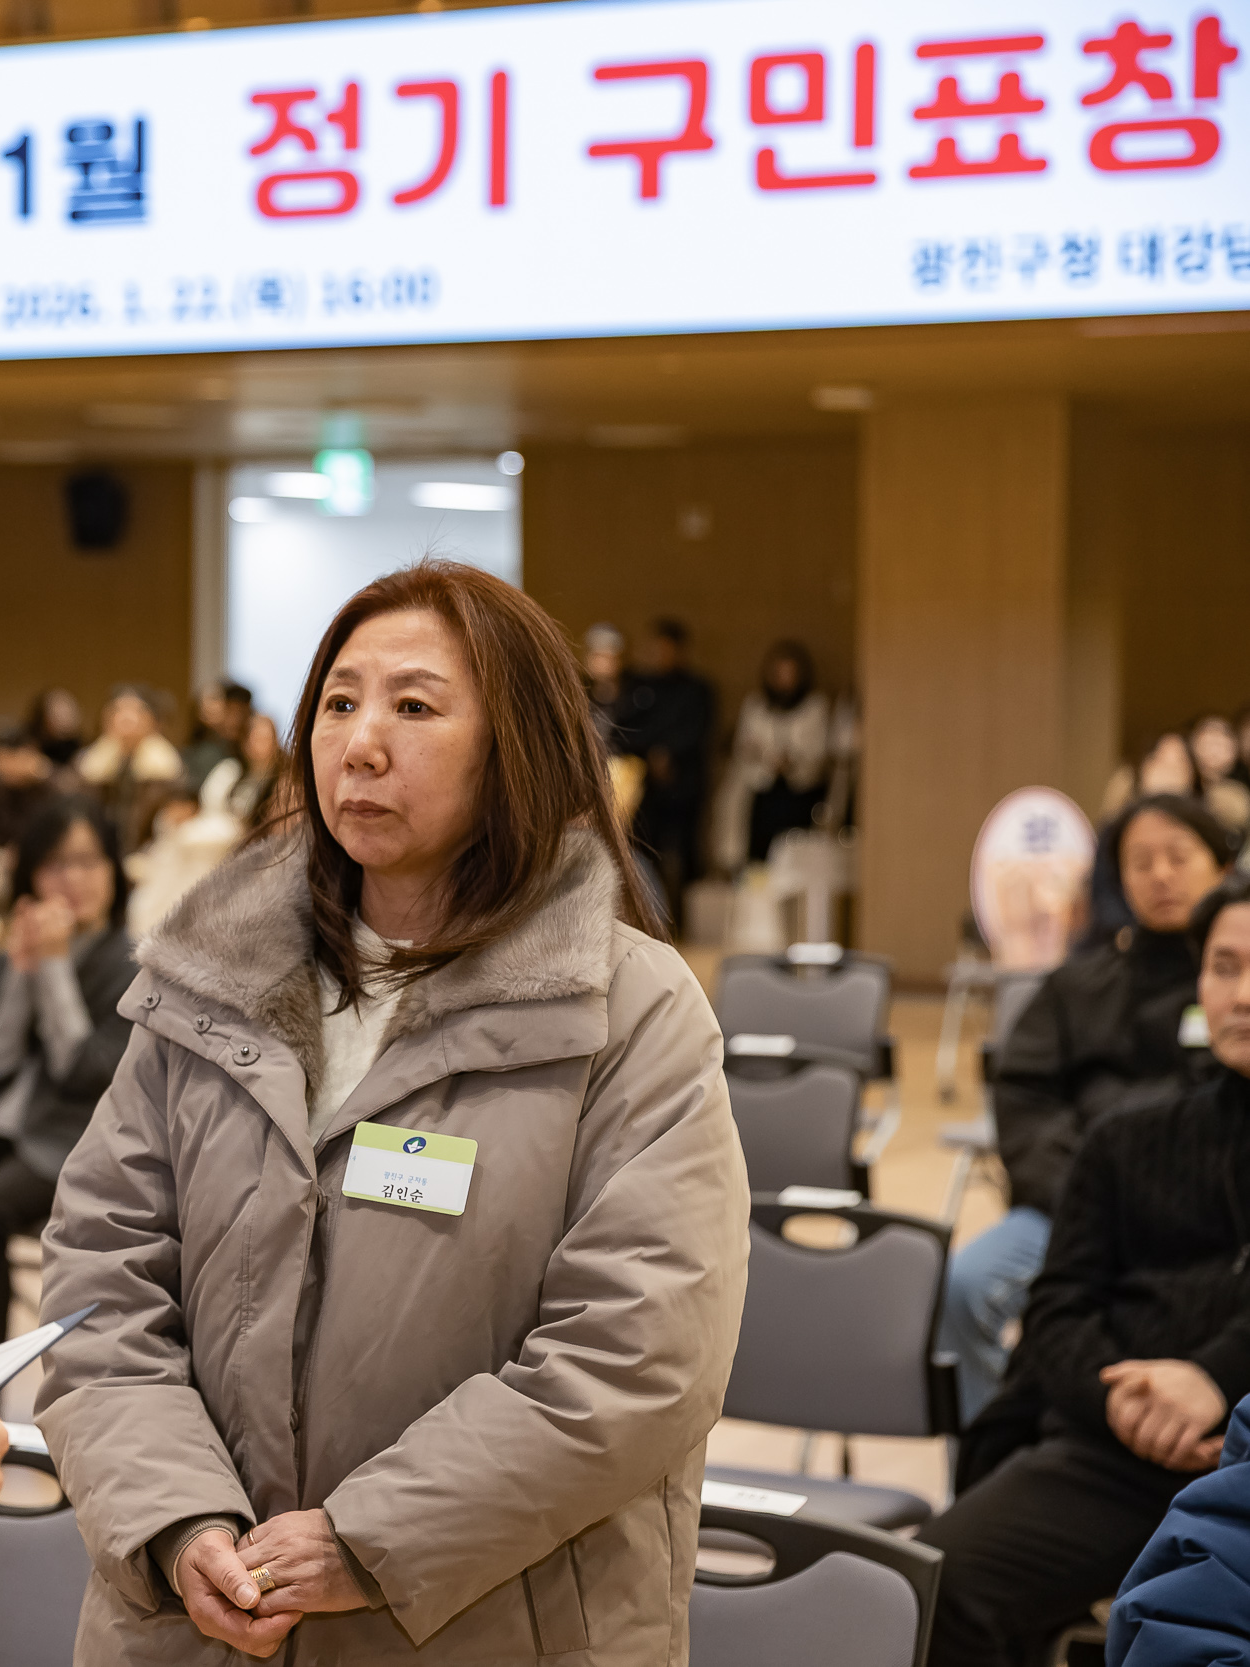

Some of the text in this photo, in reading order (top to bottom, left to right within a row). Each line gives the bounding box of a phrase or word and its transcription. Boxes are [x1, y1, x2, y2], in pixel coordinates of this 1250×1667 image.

[0, 114, 150, 227] 1월
[248, 70, 509, 220] 정기
[588, 14, 1239, 202] 구민표창
[381, 1184, 424, 1204] 김인순
